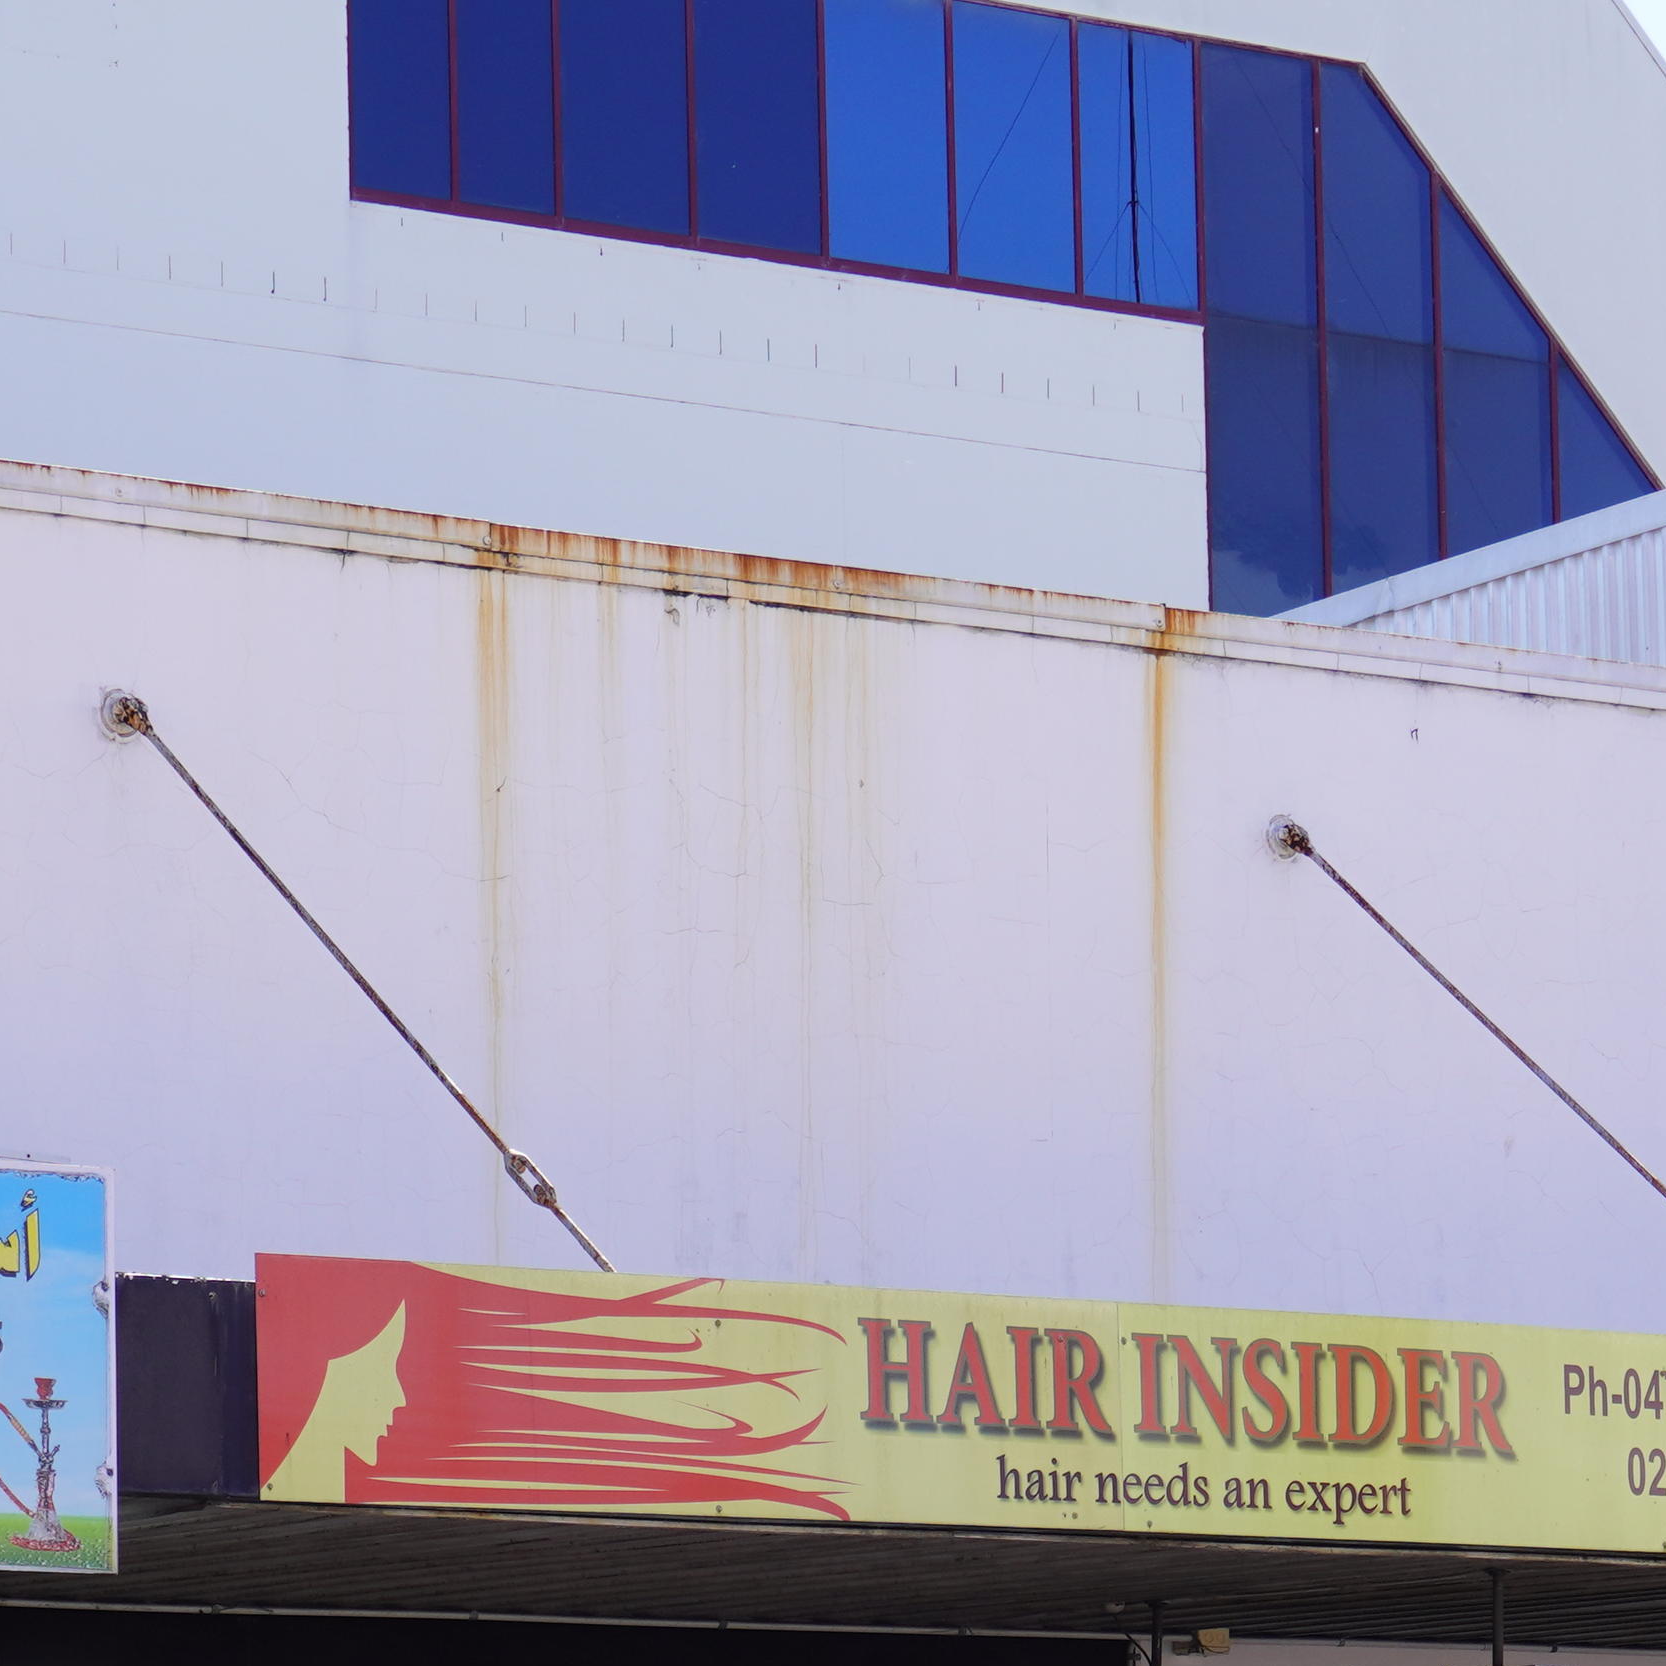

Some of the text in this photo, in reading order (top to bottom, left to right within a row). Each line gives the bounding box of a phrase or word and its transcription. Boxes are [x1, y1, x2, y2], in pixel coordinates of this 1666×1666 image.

[858, 1317, 1514, 1457] HAIR INSIDER
[997, 1453, 1412, 1526] hair needs an expert
